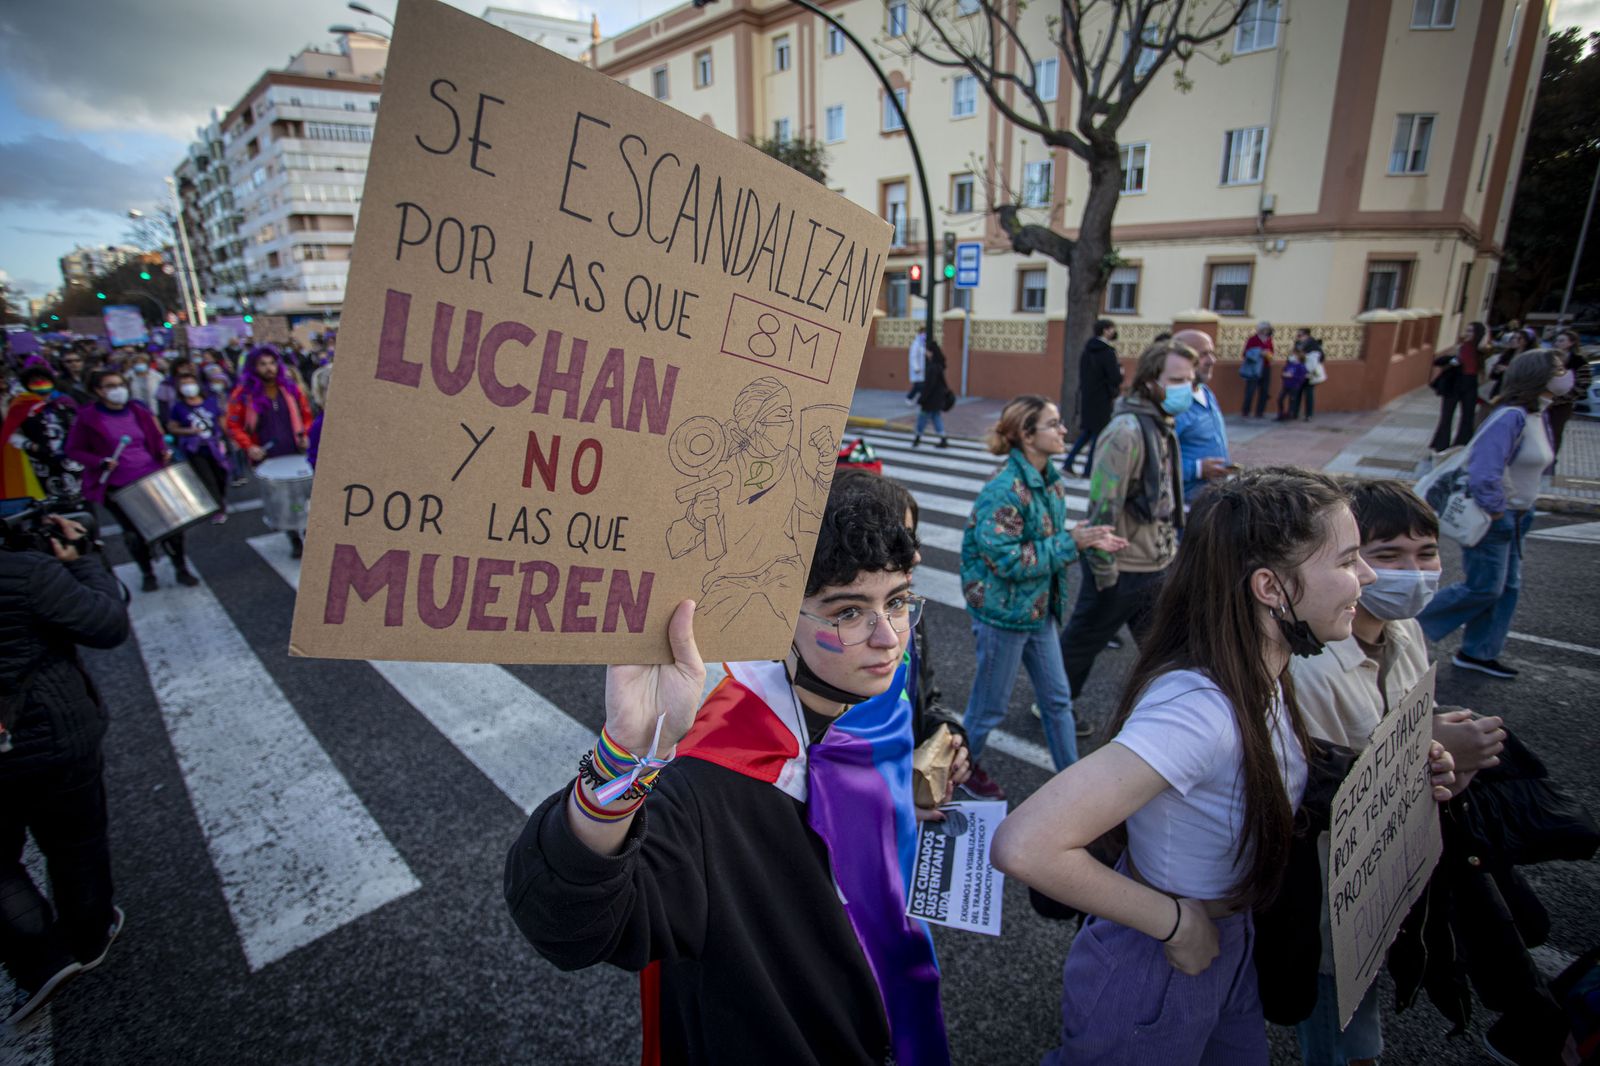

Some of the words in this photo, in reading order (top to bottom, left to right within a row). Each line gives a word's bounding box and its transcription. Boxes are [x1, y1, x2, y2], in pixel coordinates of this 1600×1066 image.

[415, 79, 505, 177] SE
[560, 111, 881, 327] ESCANDALIZAN
[395, 202, 495, 284] POR
[523, 240, 605, 312] LAS
[624, 275, 699, 339] QUE
[374, 288, 680, 435] LUCHAN
[747, 313, 820, 370] 8M
[452, 422, 494, 482] Y
[521, 430, 603, 495] NO
[344, 484, 444, 534] POR
[488, 502, 551, 545] LAS
[566, 511, 629, 555] QUE
[323, 544, 656, 634] MUEREN
[1335, 765, 1372, 838] SIGO
[1375, 692, 1429, 780] FLIPANDO
[979, 818, 985, 826] Y
[1334, 826, 1357, 877] POR
[1363, 763, 1401, 832] TENER
[1403, 731, 1422, 788] QUE
[917, 830, 935, 889] CUIDADOS
[925, 849, 945, 917] SUSTENTAN
[935, 834, 946, 849] LA
[965, 872, 972, 882] LA
[973, 872, 982, 909] TRABAJO
[1334, 811, 1397, 925] PROTESTAR
[912, 891, 926, 915] LOS
[937, 891, 951, 921] VIDA
[960, 883, 972, 922] EXIGIMOS
[971, 911, 979, 924] DEL
